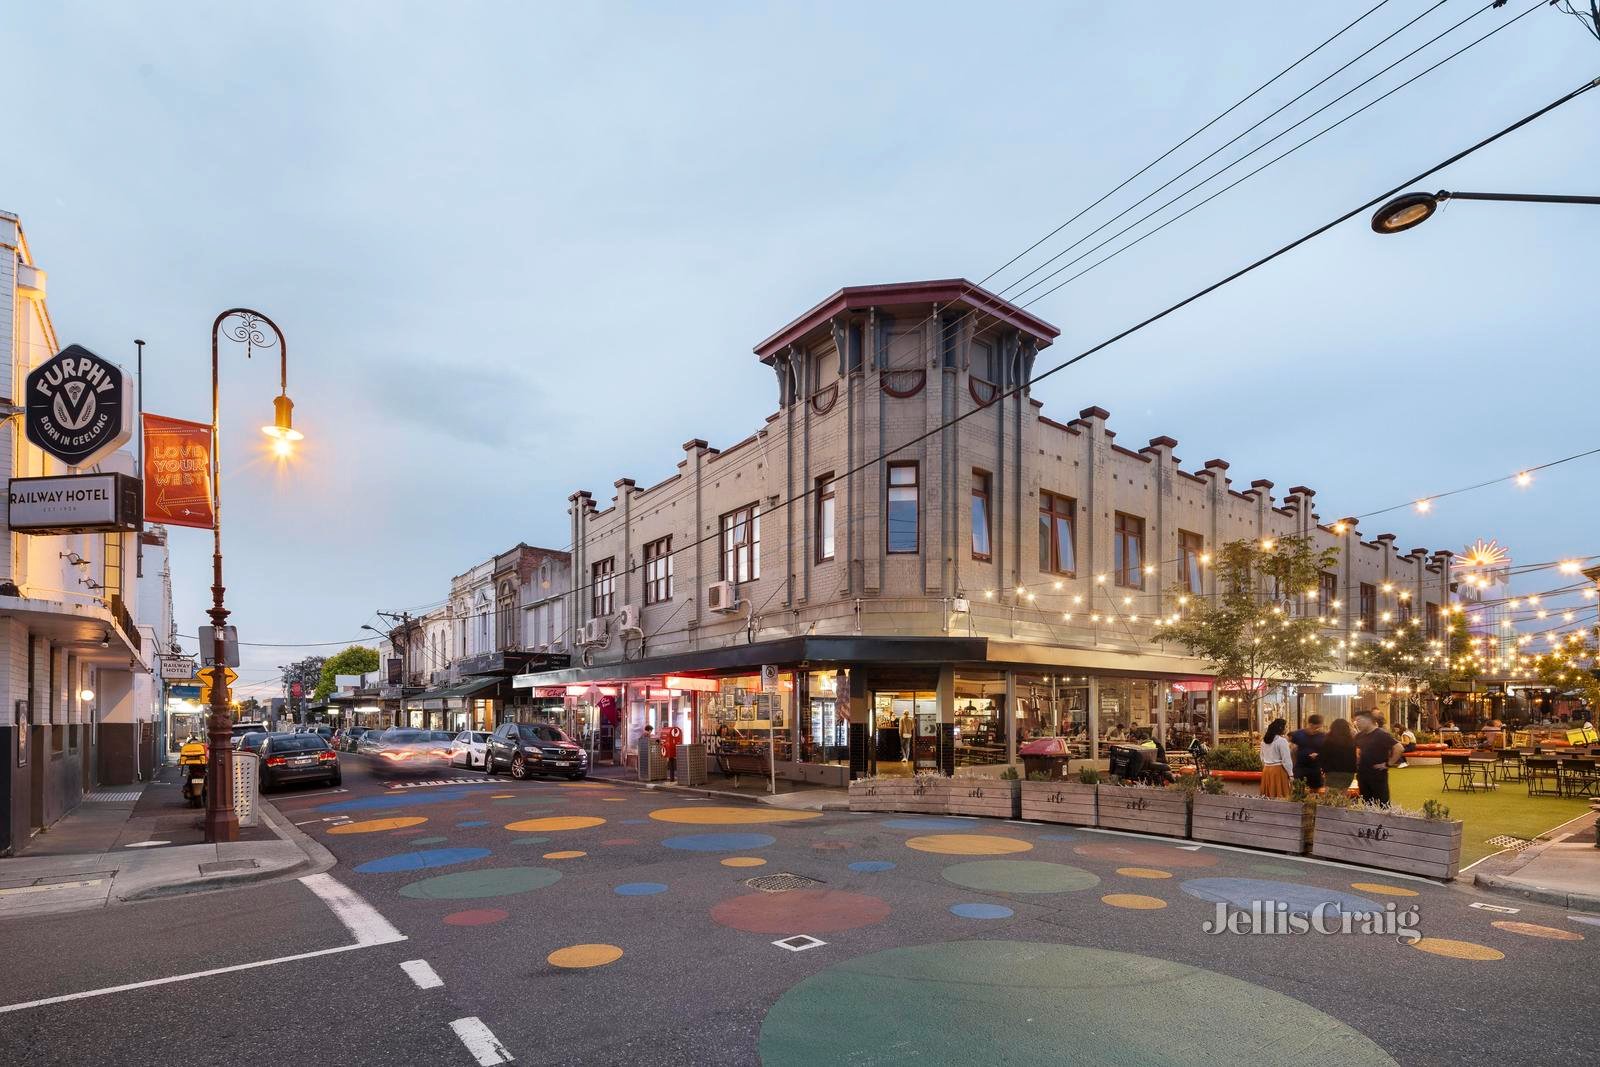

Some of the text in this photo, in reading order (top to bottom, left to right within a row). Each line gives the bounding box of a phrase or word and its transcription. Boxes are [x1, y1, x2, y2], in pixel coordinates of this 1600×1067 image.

[36, 358, 114, 397] FURPHY
[40, 413, 108, 446] BORN IN GEELONG
[153, 445, 204, 459] LOVE
[153, 458, 208, 473] YOUR
[153, 472, 205, 486] WEST
[10, 488, 109, 505] RAILWAY HOTEL
